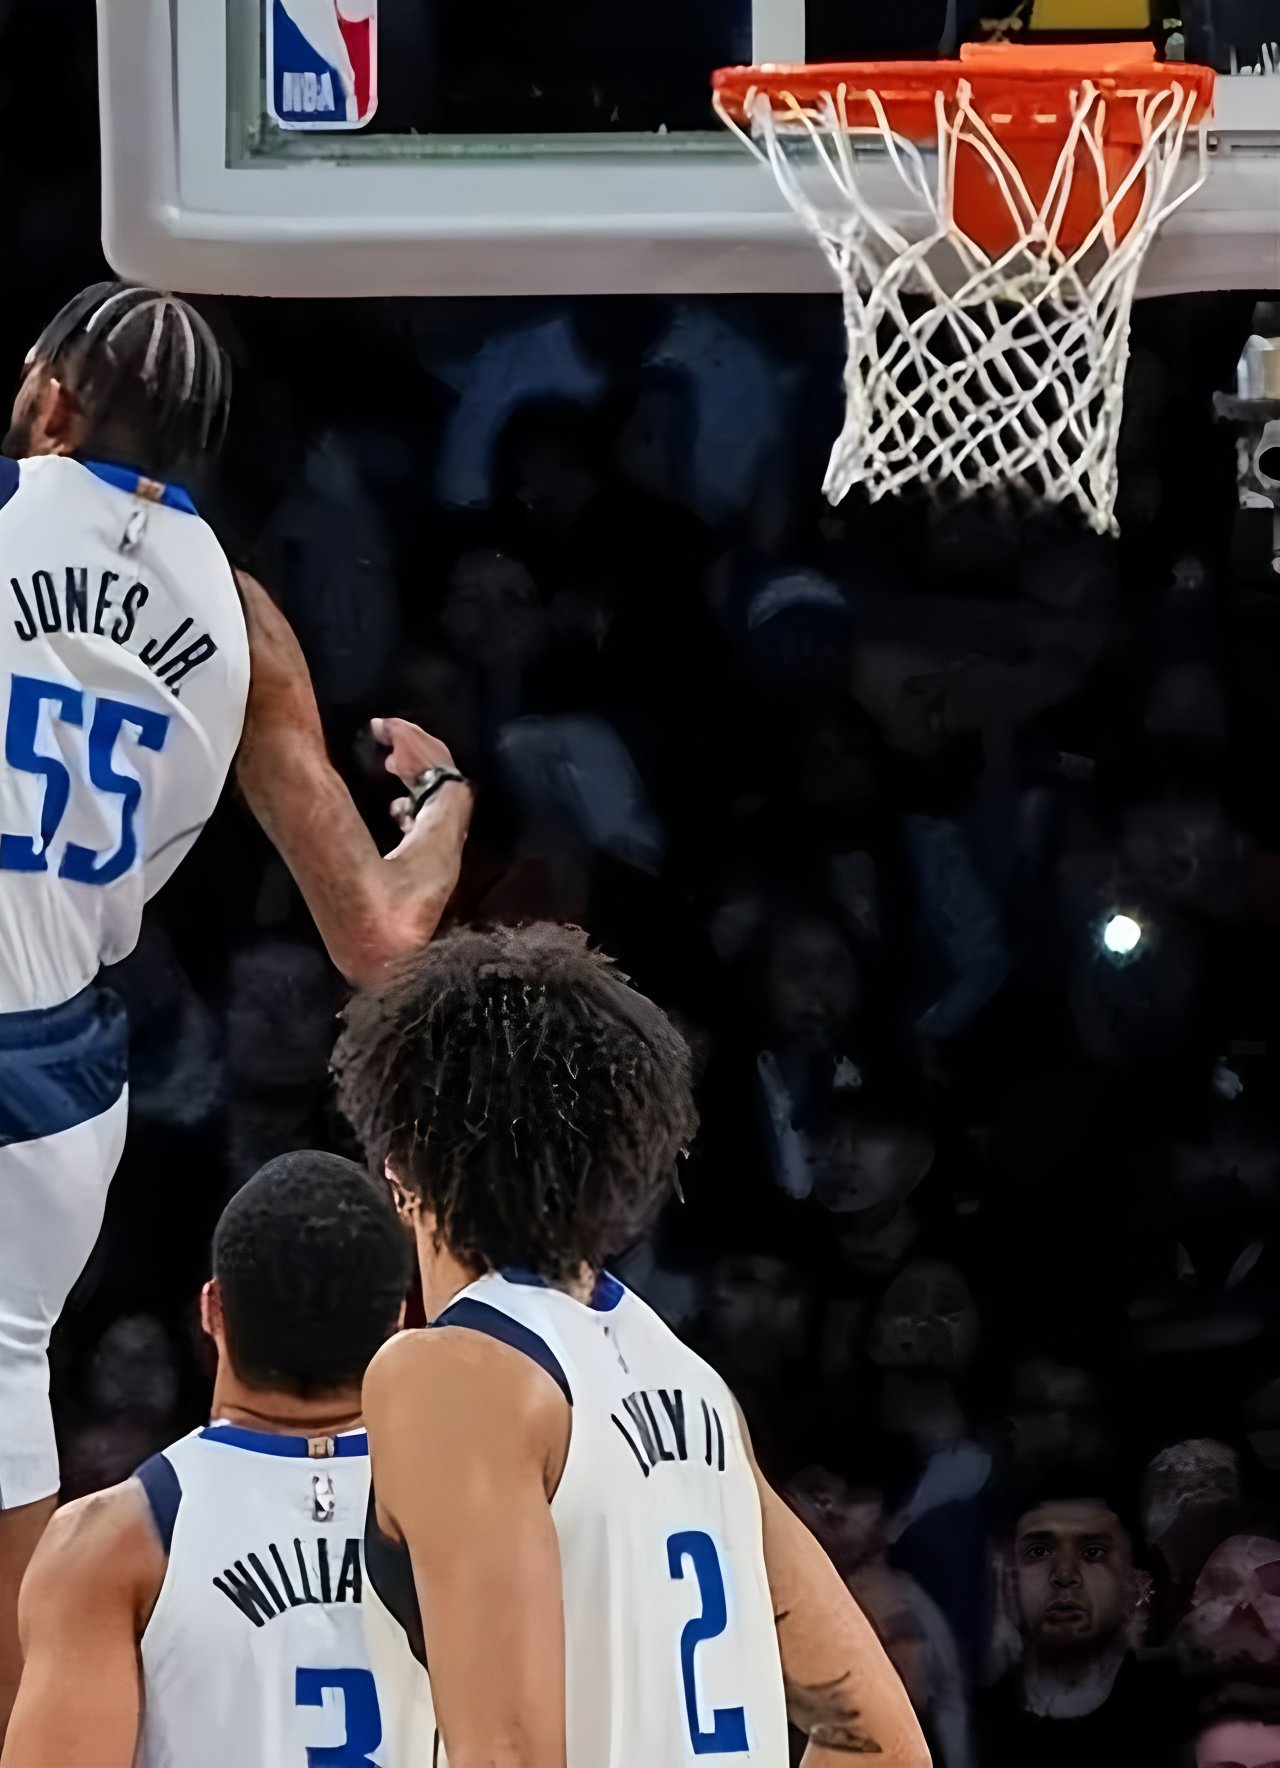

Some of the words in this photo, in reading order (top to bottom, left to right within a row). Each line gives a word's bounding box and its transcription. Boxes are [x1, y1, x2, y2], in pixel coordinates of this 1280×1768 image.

[282, 71, 335, 112] NBA
[10, 567, 149, 646] JONES
[666, 1530, 750, 1755] 2
